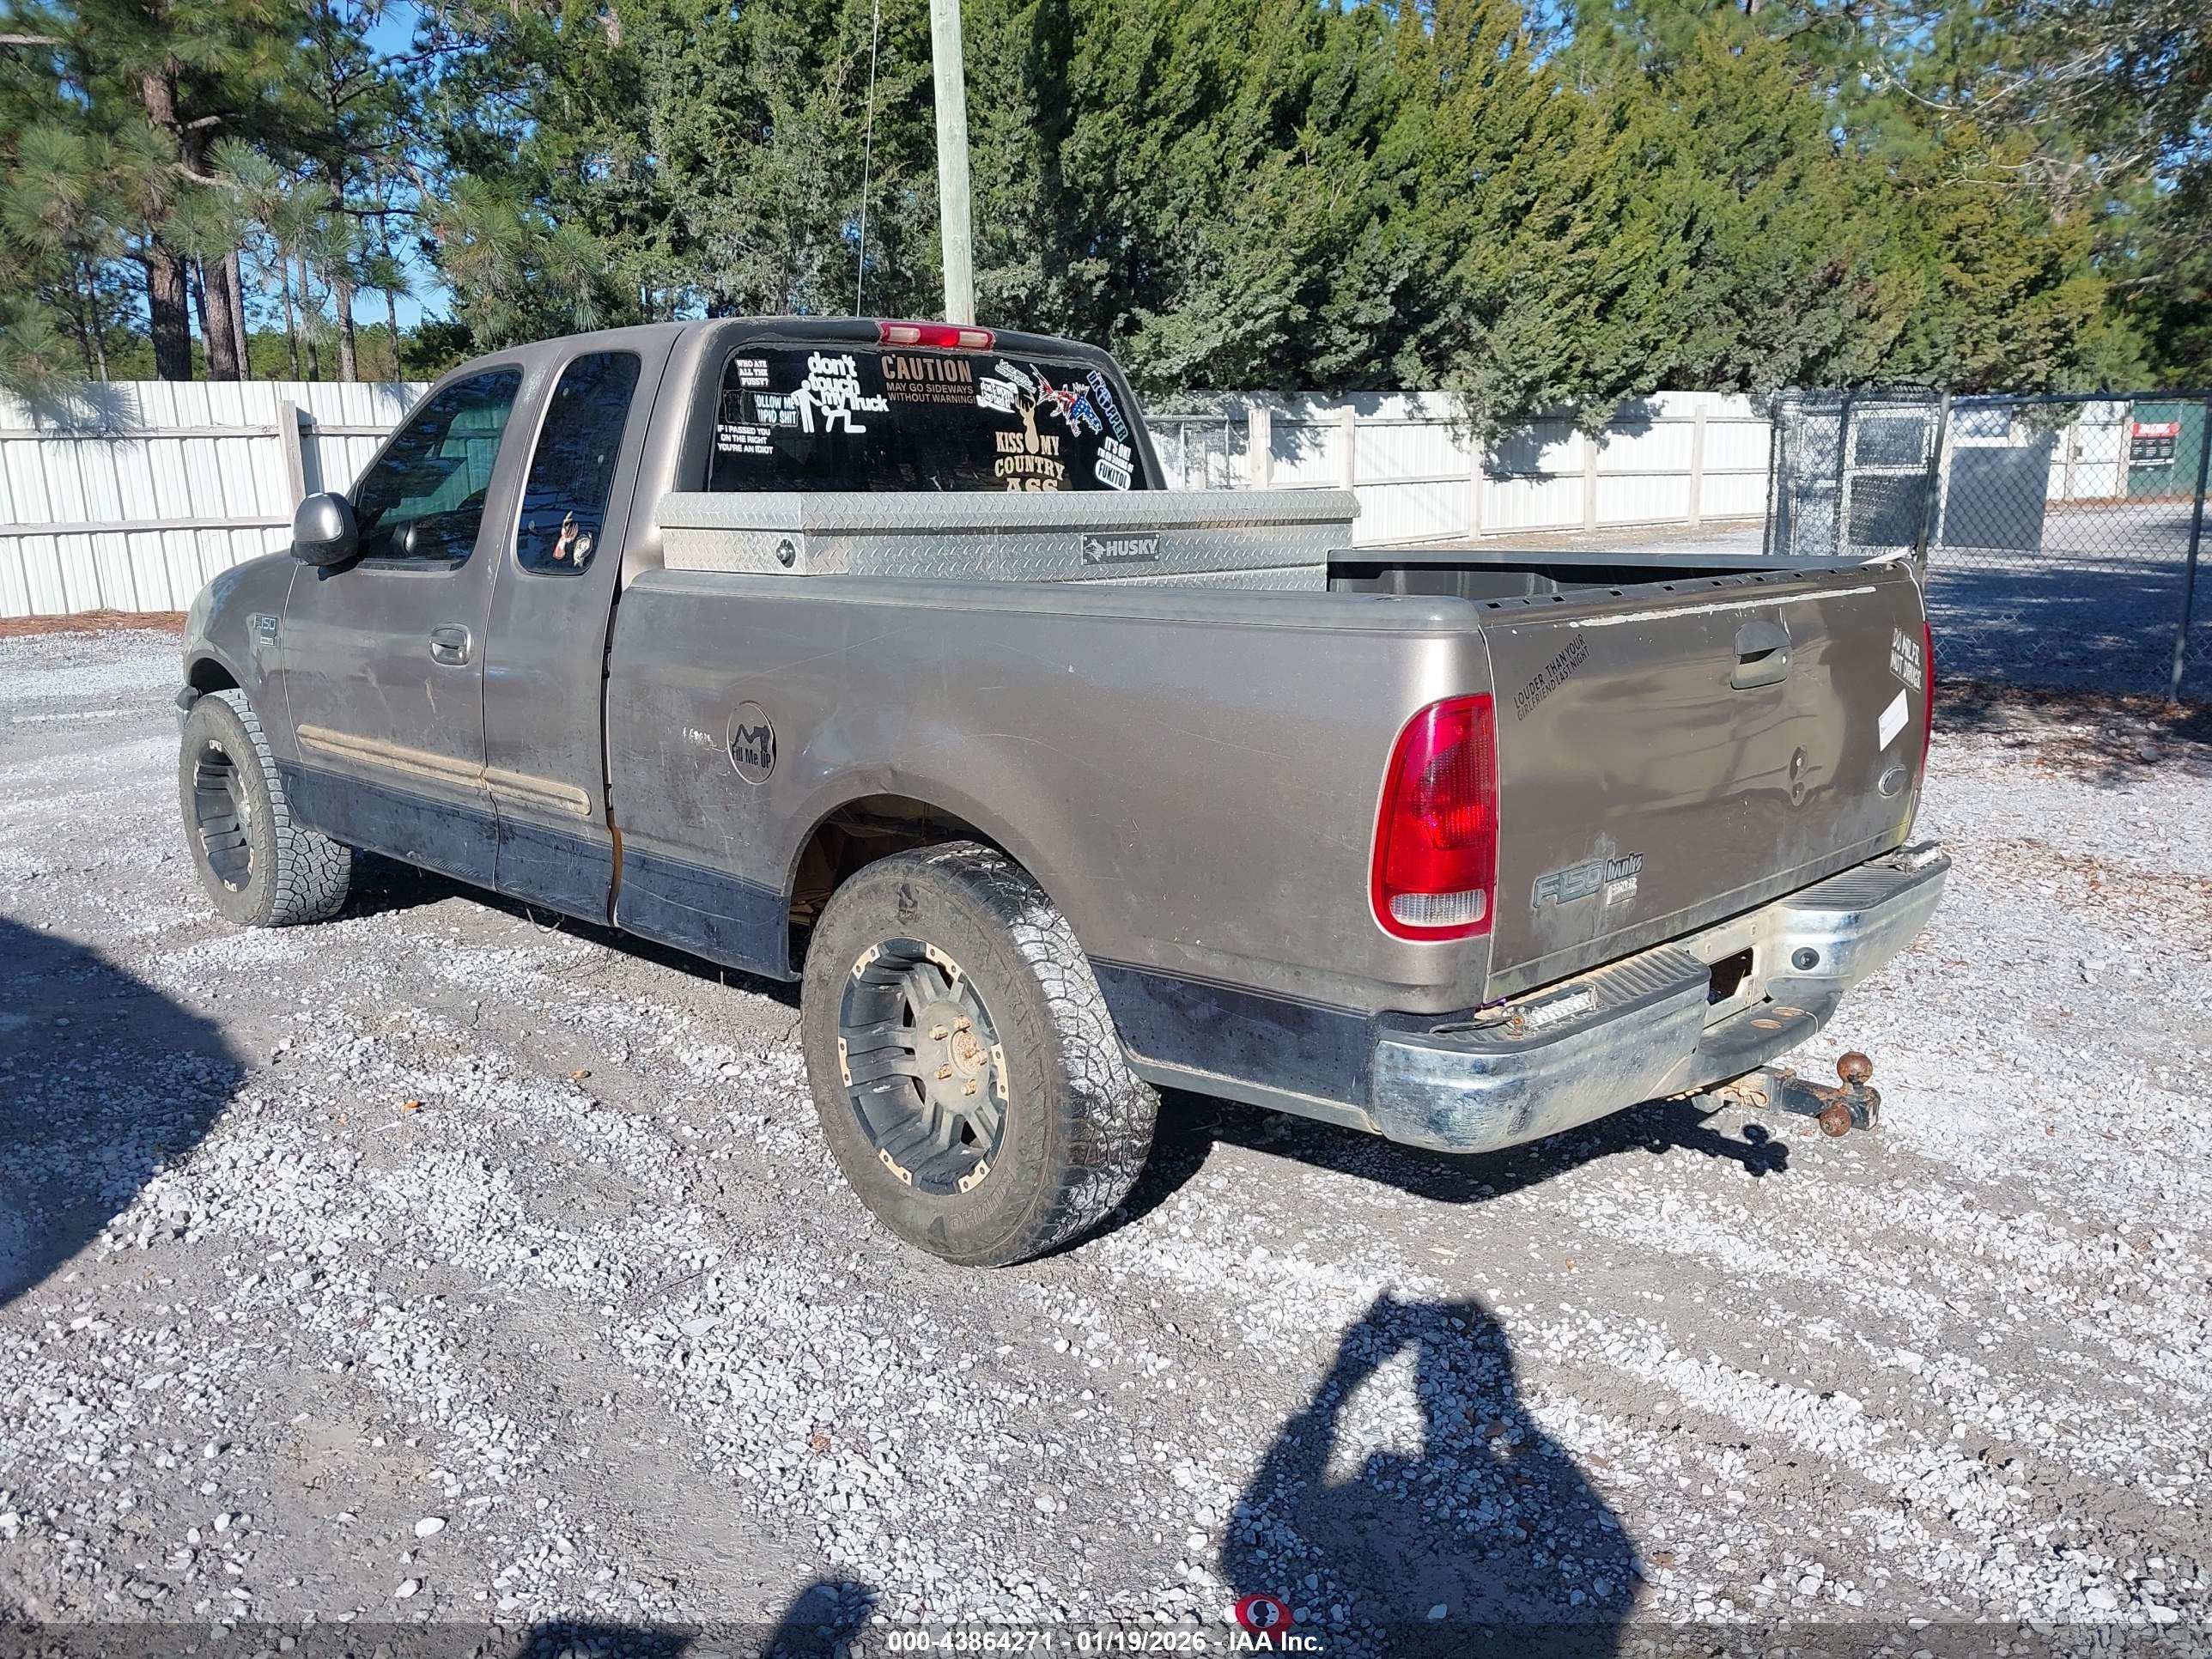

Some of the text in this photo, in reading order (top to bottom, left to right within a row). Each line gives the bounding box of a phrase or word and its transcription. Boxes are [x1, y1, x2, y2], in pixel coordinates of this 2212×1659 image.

[736, 359, 768, 368] WHO ATE
[753, 368, 769, 377] THE
[807, 351, 858, 378] don't
[881, 355, 973, 383] CAUTION
[808, 372, 860, 395] touch
[885, 382, 974, 395] MAY GO SIDEWAYS
[820, 390, 846, 410] my
[887, 392, 975, 404] WITHOUT WARNING!
[779, 410, 797, 424] SHIT
[717, 424, 725, 433] IF
[728, 426, 756, 434] PASSED
[757, 428, 771, 436] YOU
[717, 442, 774, 454] YOU'RE AN IDIOT
[720, 434, 768, 445] ON THE RIGHT
[995, 431, 1060, 456] KISS MY
[1104, 436, 1119, 454] IT'S
[994, 454, 1065, 481] COUNTRY
[1098, 461, 1127, 489] FUKITOL
[1006, 477, 1059, 492] ASS
[1106, 538, 1158, 556] HUSKY
[1893, 628, 1902, 651] DO
[1890, 649, 1904, 674] NOT
[1513, 634, 1586, 709] LOUDER THAN YOUR
[1517, 645, 1589, 722] GIRLFRIEND LAST NIGHT
[745, 748, 758, 765] Me
